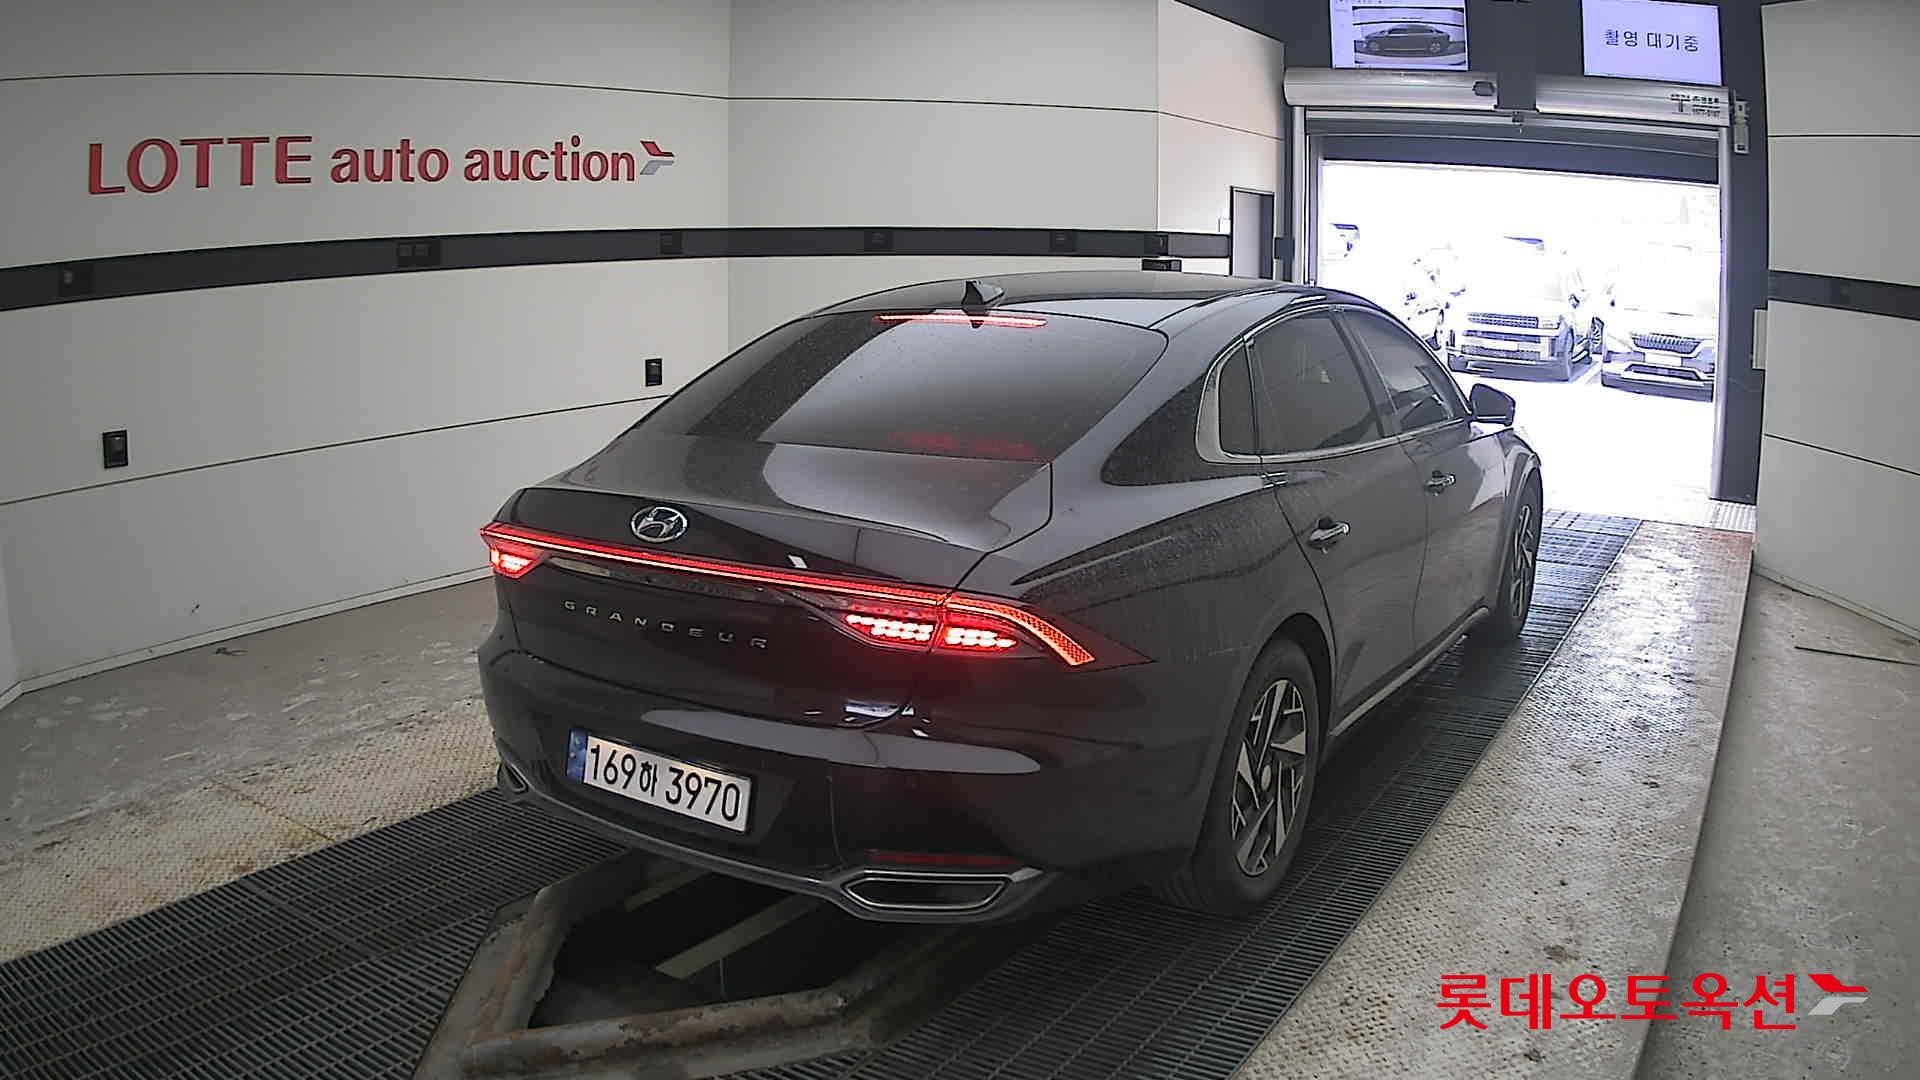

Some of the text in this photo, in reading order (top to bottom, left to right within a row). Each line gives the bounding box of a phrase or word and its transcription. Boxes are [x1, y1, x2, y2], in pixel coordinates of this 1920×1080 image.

[1604, 29, 1699, 52] 촬영 대기중
[88, 135, 636, 195] LOTTE auto auction
[563, 598, 769, 650] GRANDEUR
[664, 766, 742, 823] 3970
